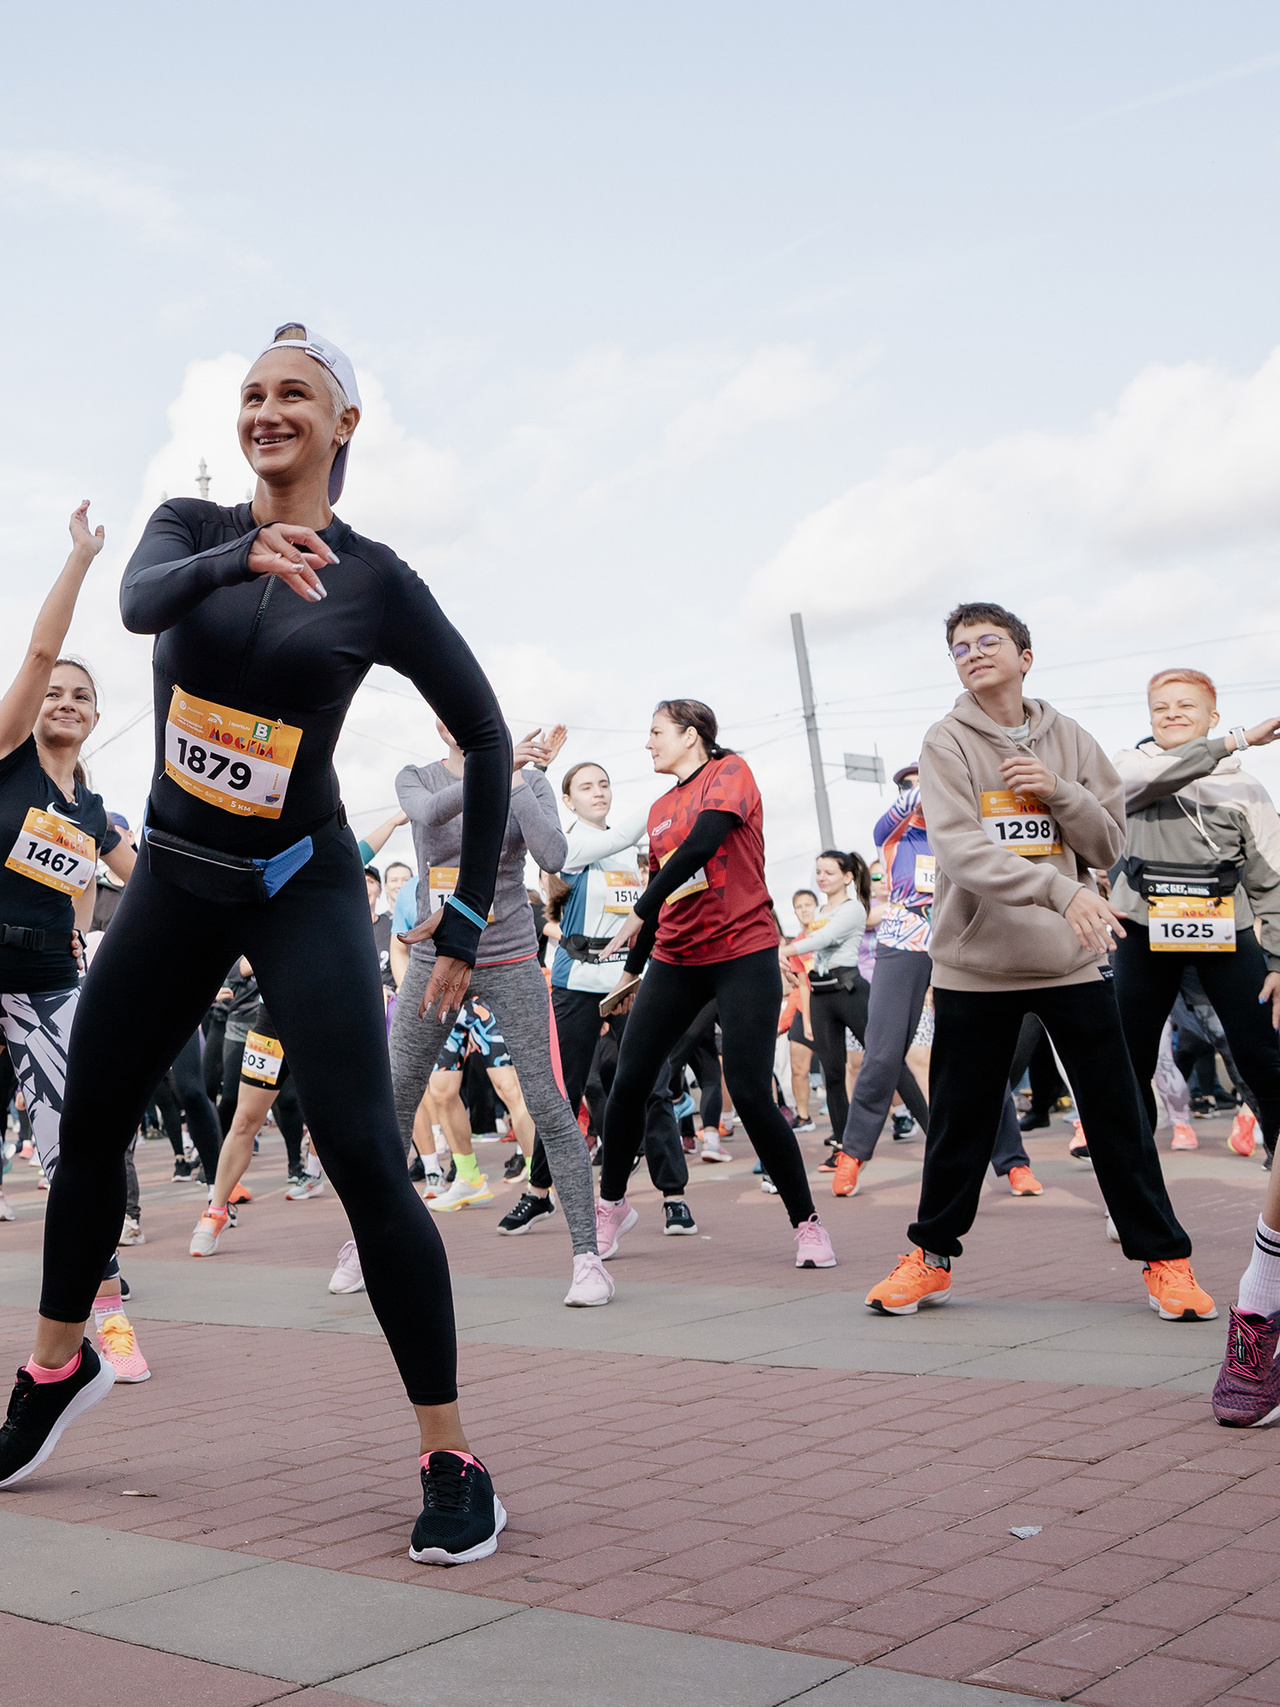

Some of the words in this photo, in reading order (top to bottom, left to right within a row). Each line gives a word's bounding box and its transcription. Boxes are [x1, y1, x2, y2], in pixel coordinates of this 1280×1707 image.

[209, 728, 274, 759] МОСКВА
[177, 737, 252, 791] 1879
[995, 820, 1051, 840] 1298
[26, 841, 80, 876] 1467
[614, 890, 639, 903] 1514
[1160, 923, 1215, 939] 1625
